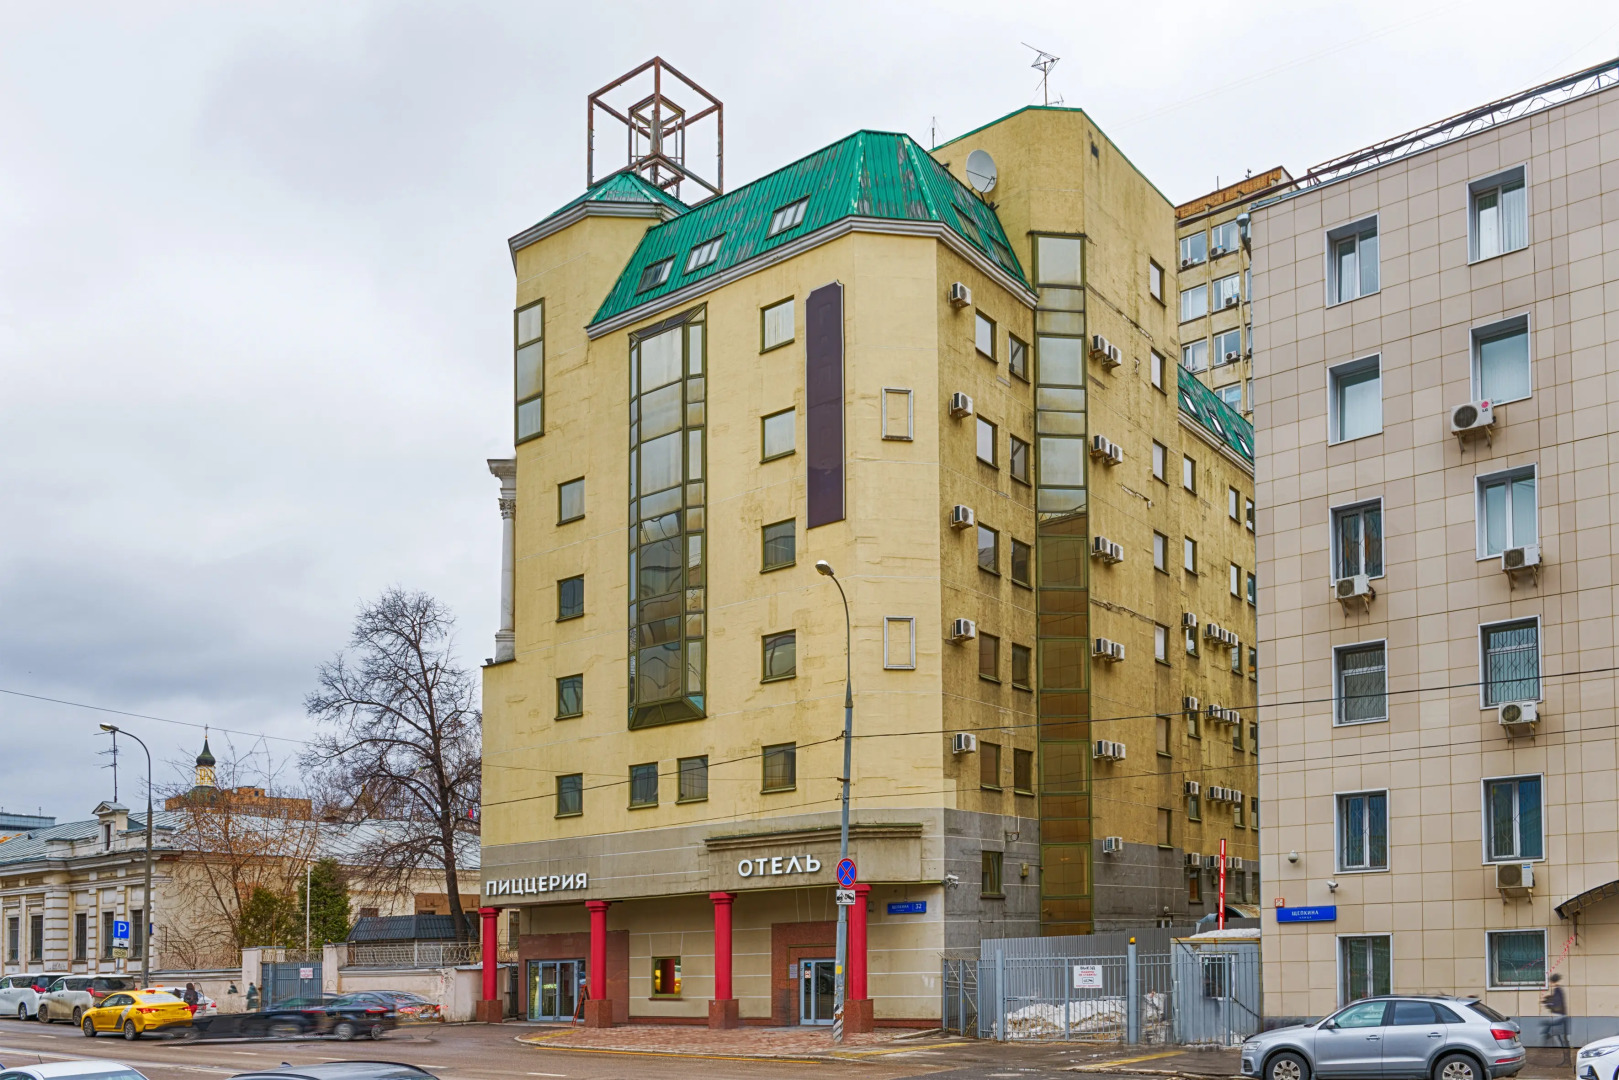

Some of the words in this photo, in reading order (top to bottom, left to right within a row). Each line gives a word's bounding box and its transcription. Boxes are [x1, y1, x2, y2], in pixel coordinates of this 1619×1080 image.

[737, 854, 821, 877] ОТЕЛЬ
[486, 872, 588, 896] ПИЦЦЕРИЯ
[117, 922, 127, 937] P
